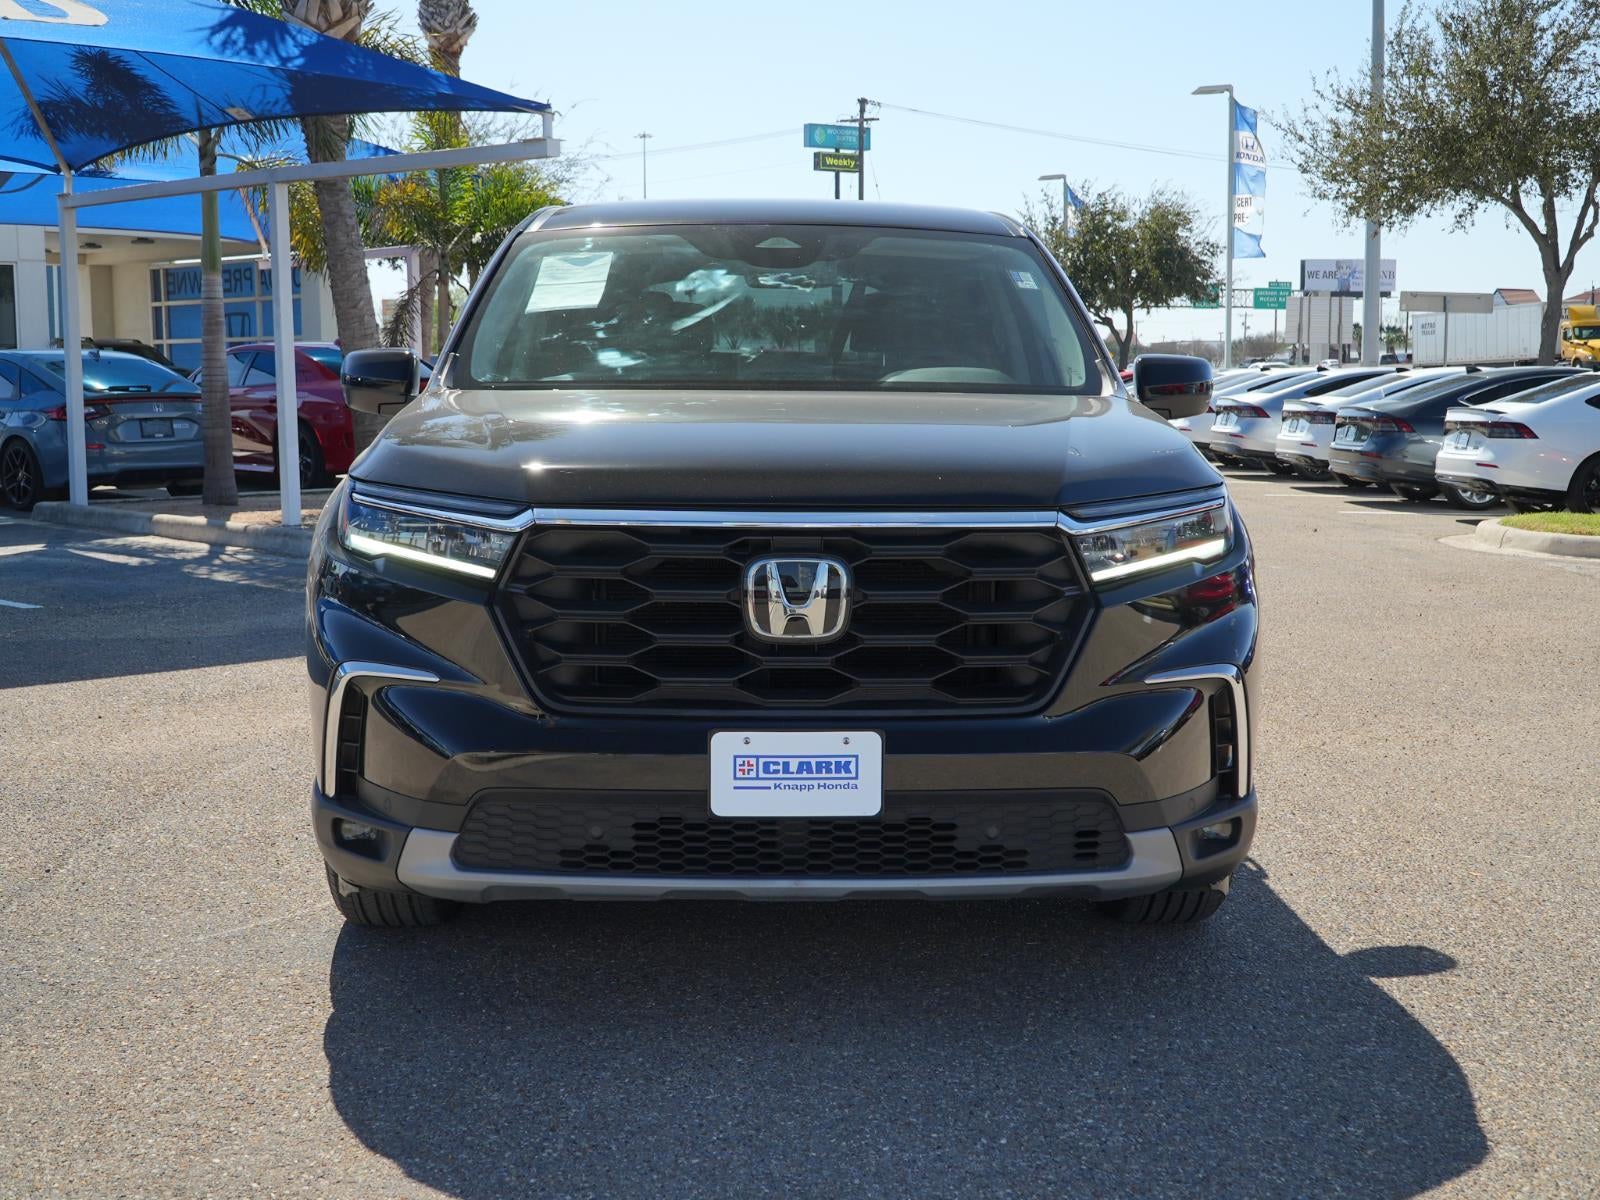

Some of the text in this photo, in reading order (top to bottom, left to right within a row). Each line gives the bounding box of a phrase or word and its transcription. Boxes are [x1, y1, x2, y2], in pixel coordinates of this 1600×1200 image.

[825, 156, 856, 168] Weekly
[1307, 270, 1338, 280] WE ARE
[762, 760, 853, 775] CLARK
[773, 782, 858, 792] Knapp Honda
